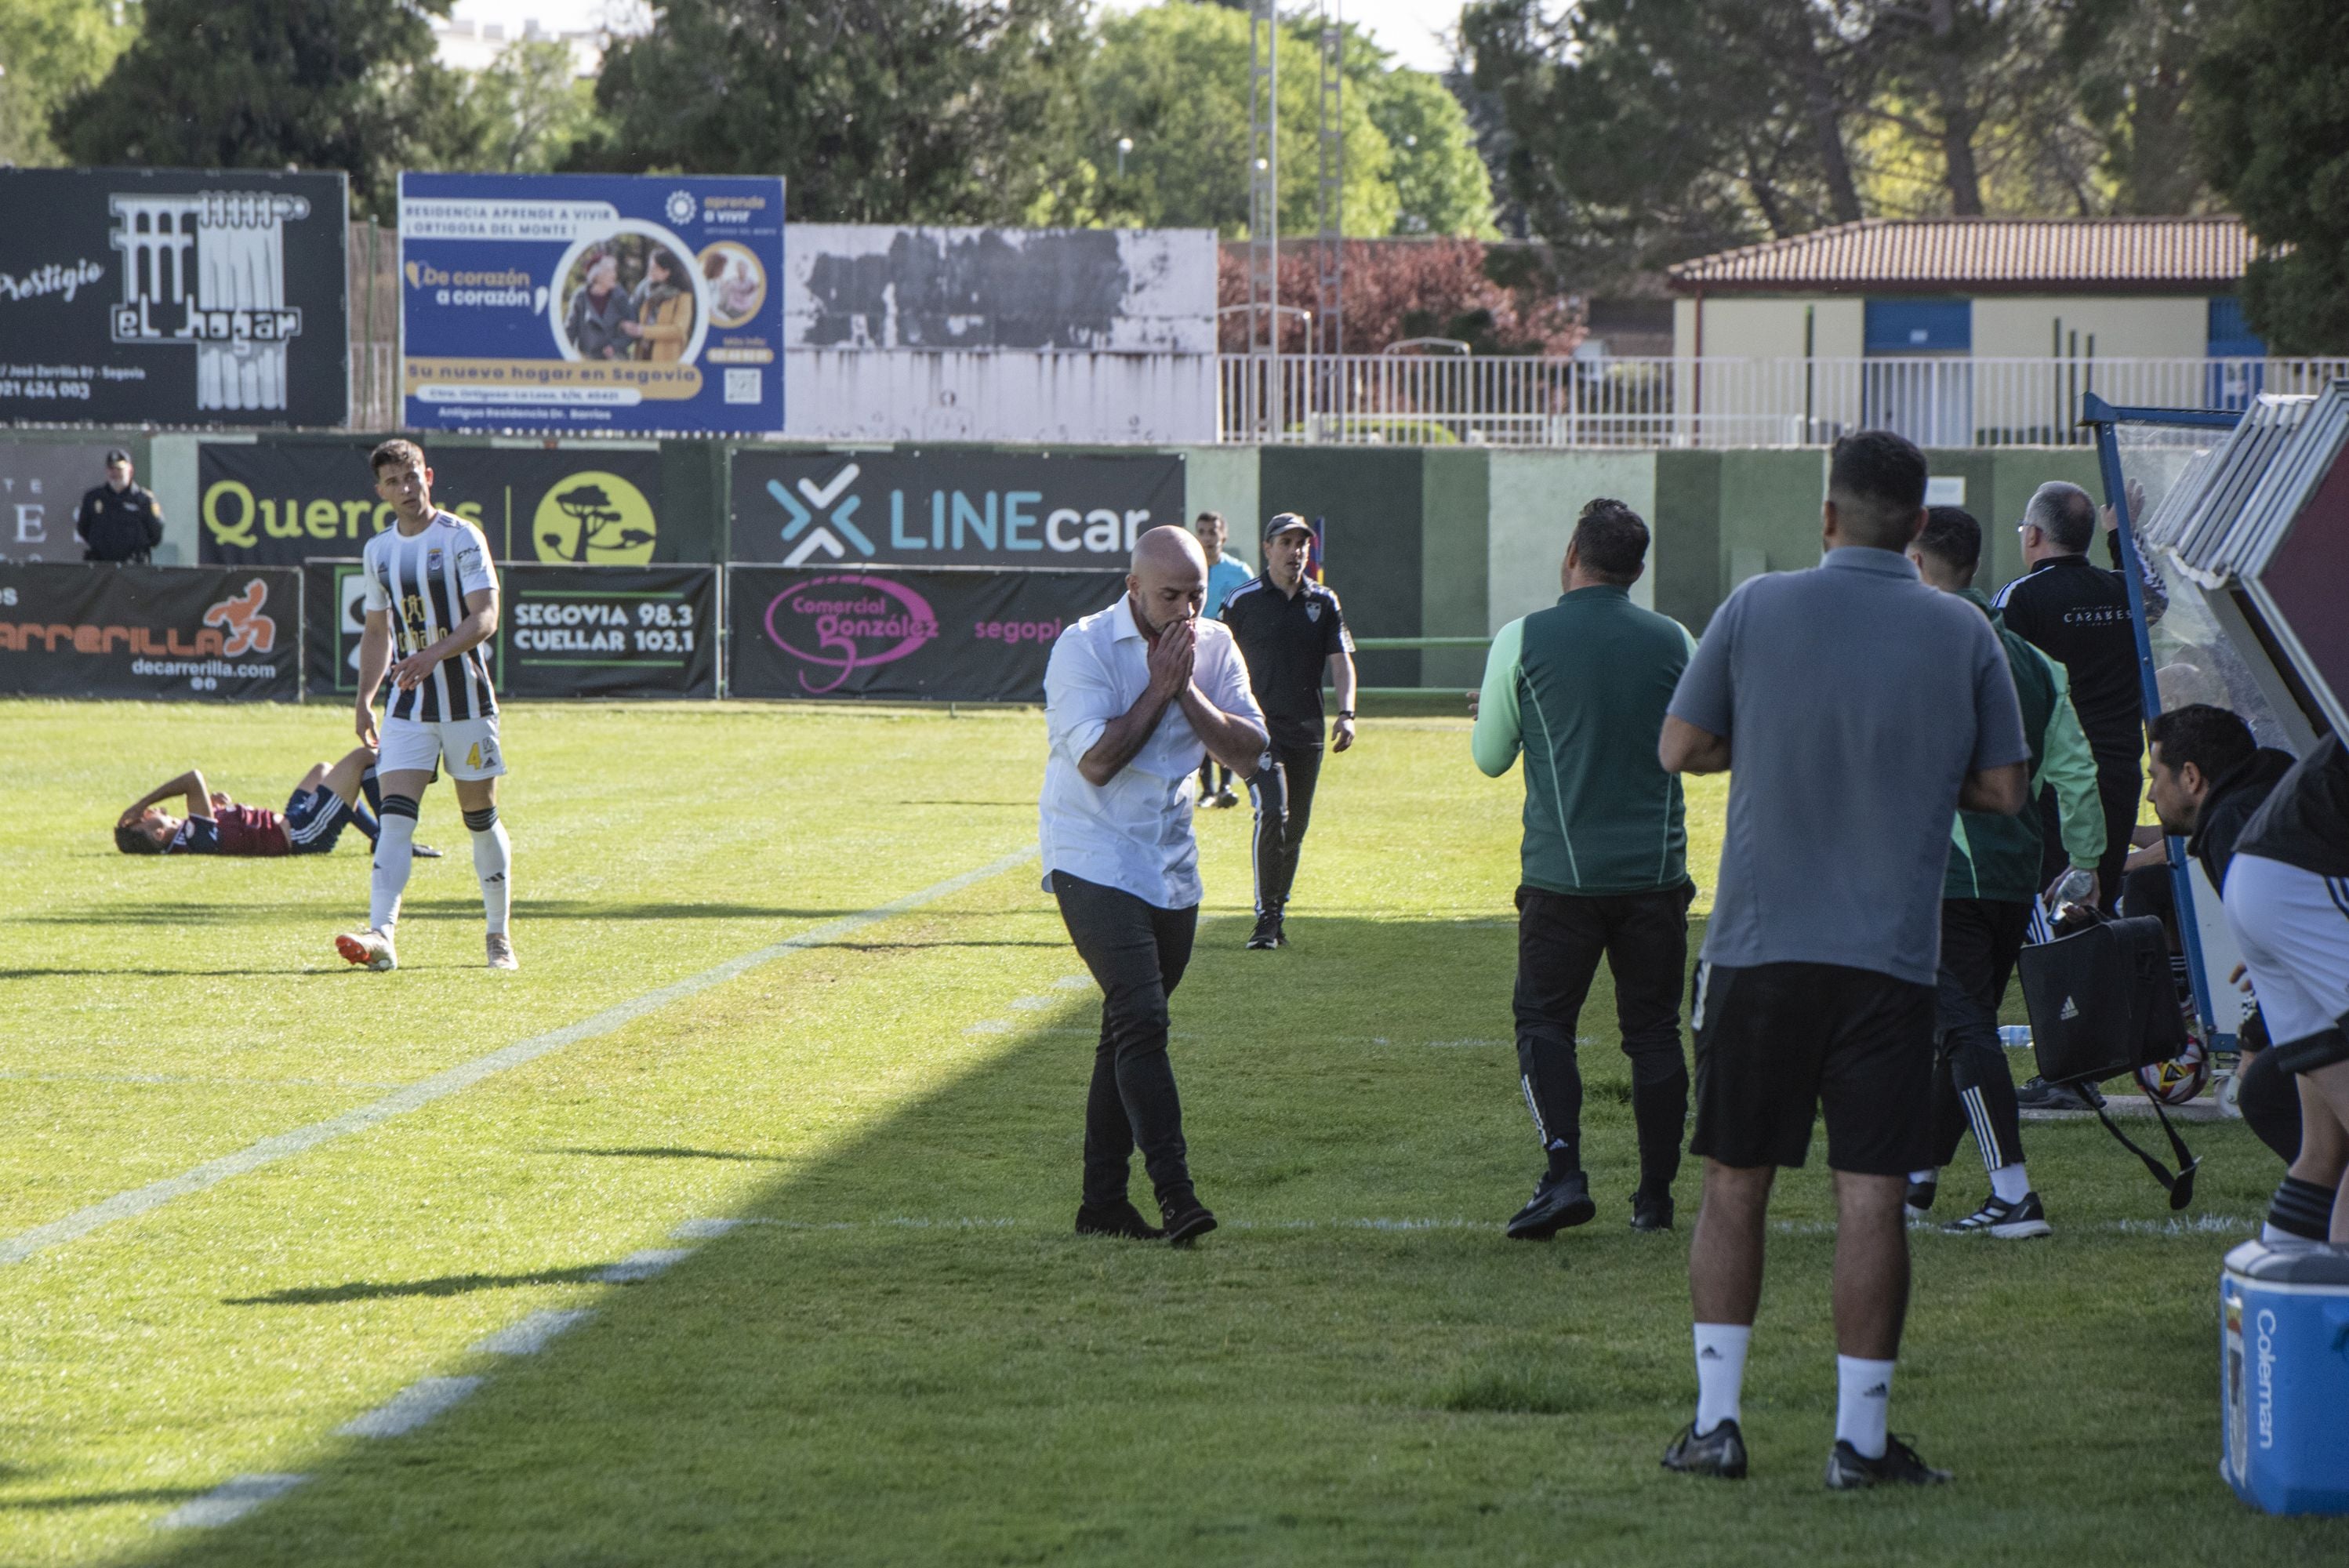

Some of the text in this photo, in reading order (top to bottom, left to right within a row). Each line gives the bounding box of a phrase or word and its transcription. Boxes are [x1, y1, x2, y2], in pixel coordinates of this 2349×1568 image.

[405, 206, 611, 220] RESIDENCIA APRENDE A VIVIR
[492, 223, 514, 234] DEL
[520, 224, 567, 235] MONTE
[424, 267, 531, 287] De corazón
[436, 286, 531, 307] a corazón
[408, 363, 696, 385] Su nuevo hogar en Segovia
[0, 379, 21, 397] 21
[202, 480, 483, 548] Quercs
[891, 489, 1150, 552] LINEcar
[514, 602, 693, 627] SEGOVIA 98.3
[793, 597, 886, 615] Comercial
[514, 629, 695, 652] CUELLAR 103.1
[132, 657, 277, 679] decarrerilla.com
[467, 742, 482, 771] 4
[2256, 1308, 2277, 1450] Coleman
